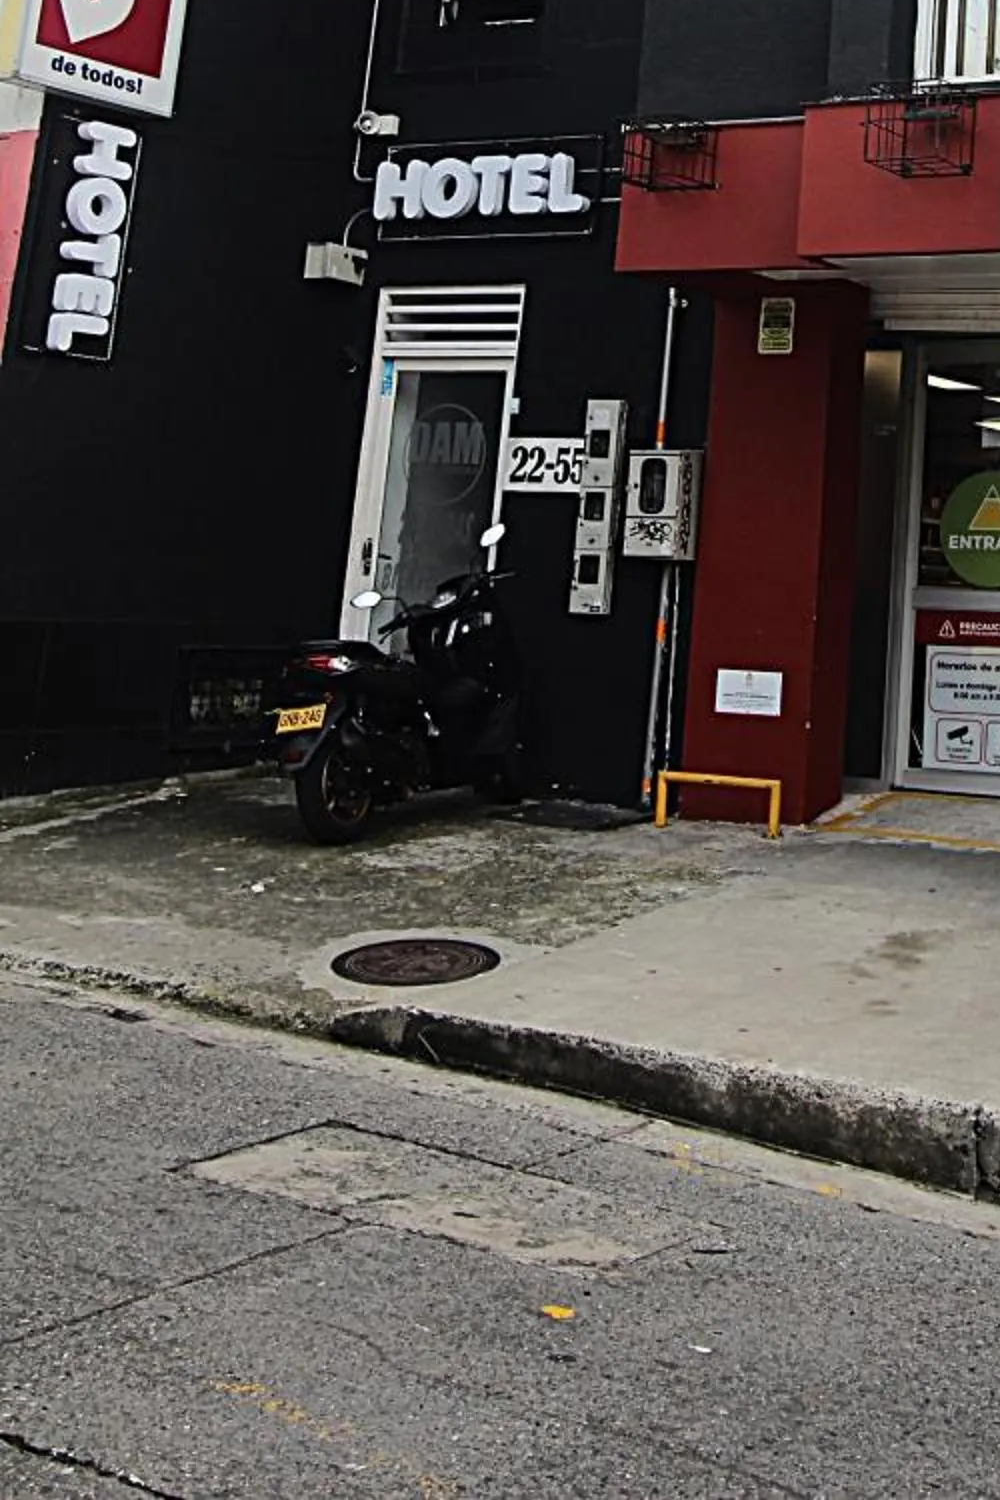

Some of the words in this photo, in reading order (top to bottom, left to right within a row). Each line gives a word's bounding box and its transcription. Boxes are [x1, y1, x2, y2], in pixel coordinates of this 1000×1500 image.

[51, 54, 76, 76] de
[81, 62, 143, 95] todos!
[373, 152, 591, 222] HOTEL
[45, 119, 138, 353] HOTEL
[509, 445, 583, 485] 22-55
